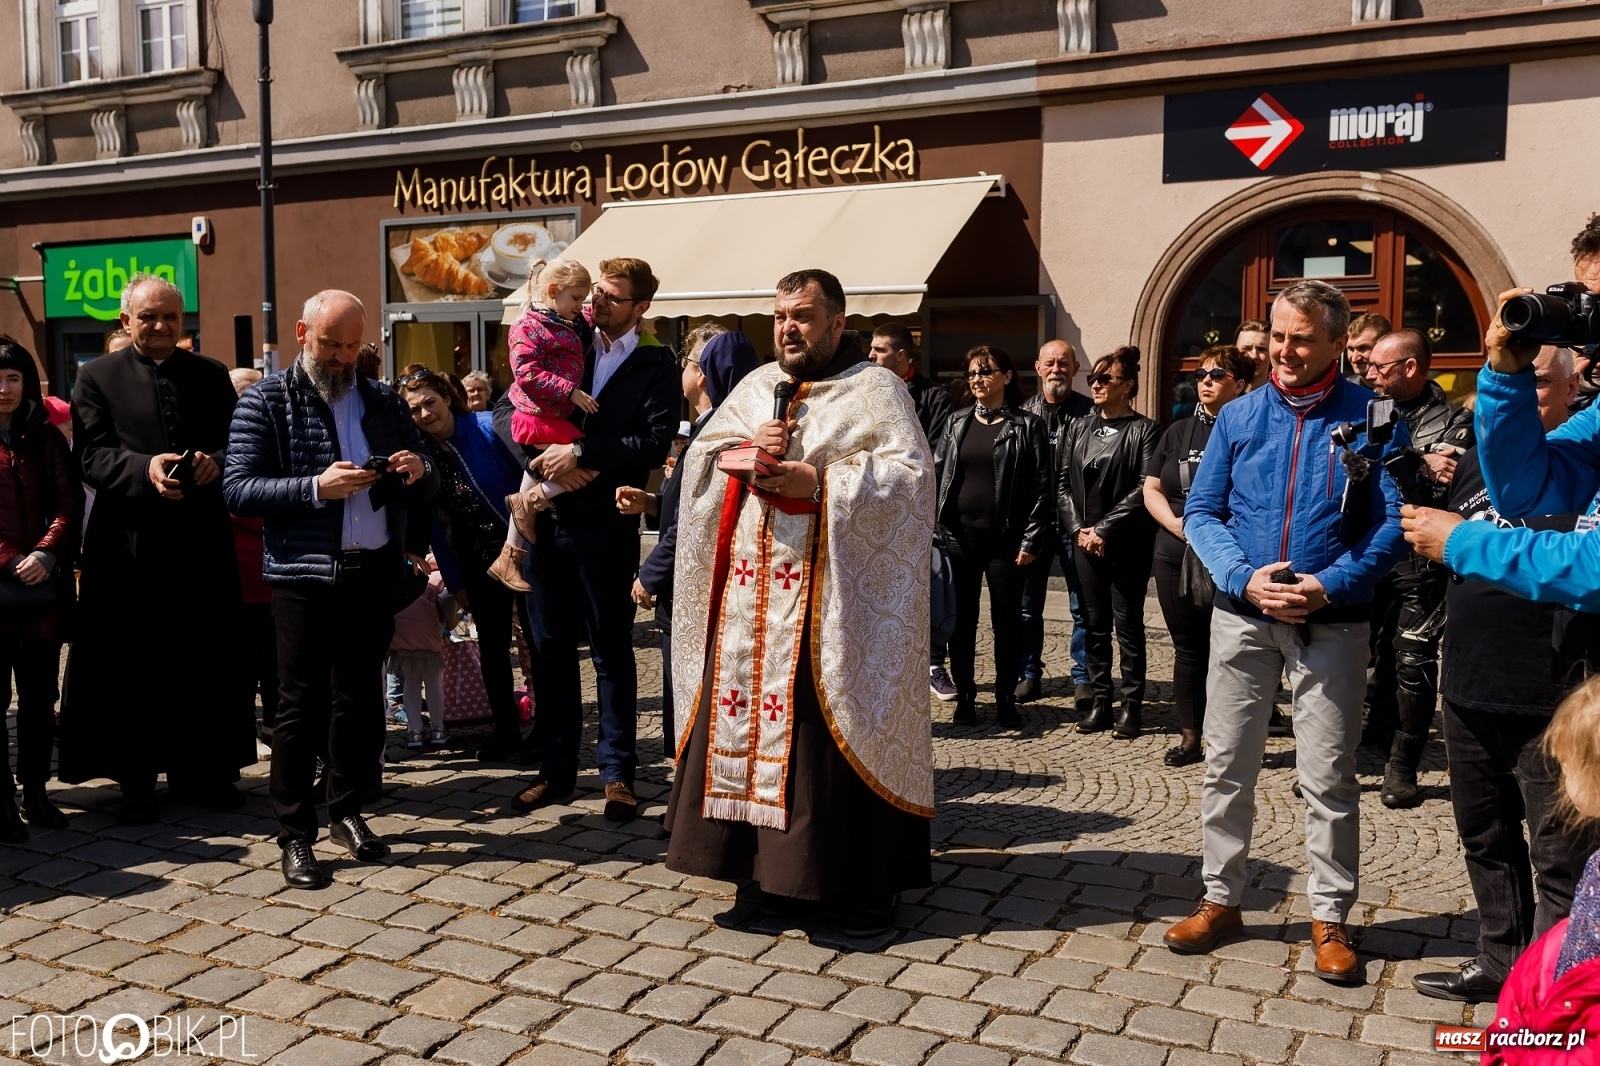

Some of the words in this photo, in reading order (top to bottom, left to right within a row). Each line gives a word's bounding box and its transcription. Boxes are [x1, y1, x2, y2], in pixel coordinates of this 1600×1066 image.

[393, 155, 592, 209] Manufaktura
[605, 144, 728, 195] Lodów
[741, 125, 914, 184] Gałeczka
[1329, 137, 1404, 149] COLLECTION
